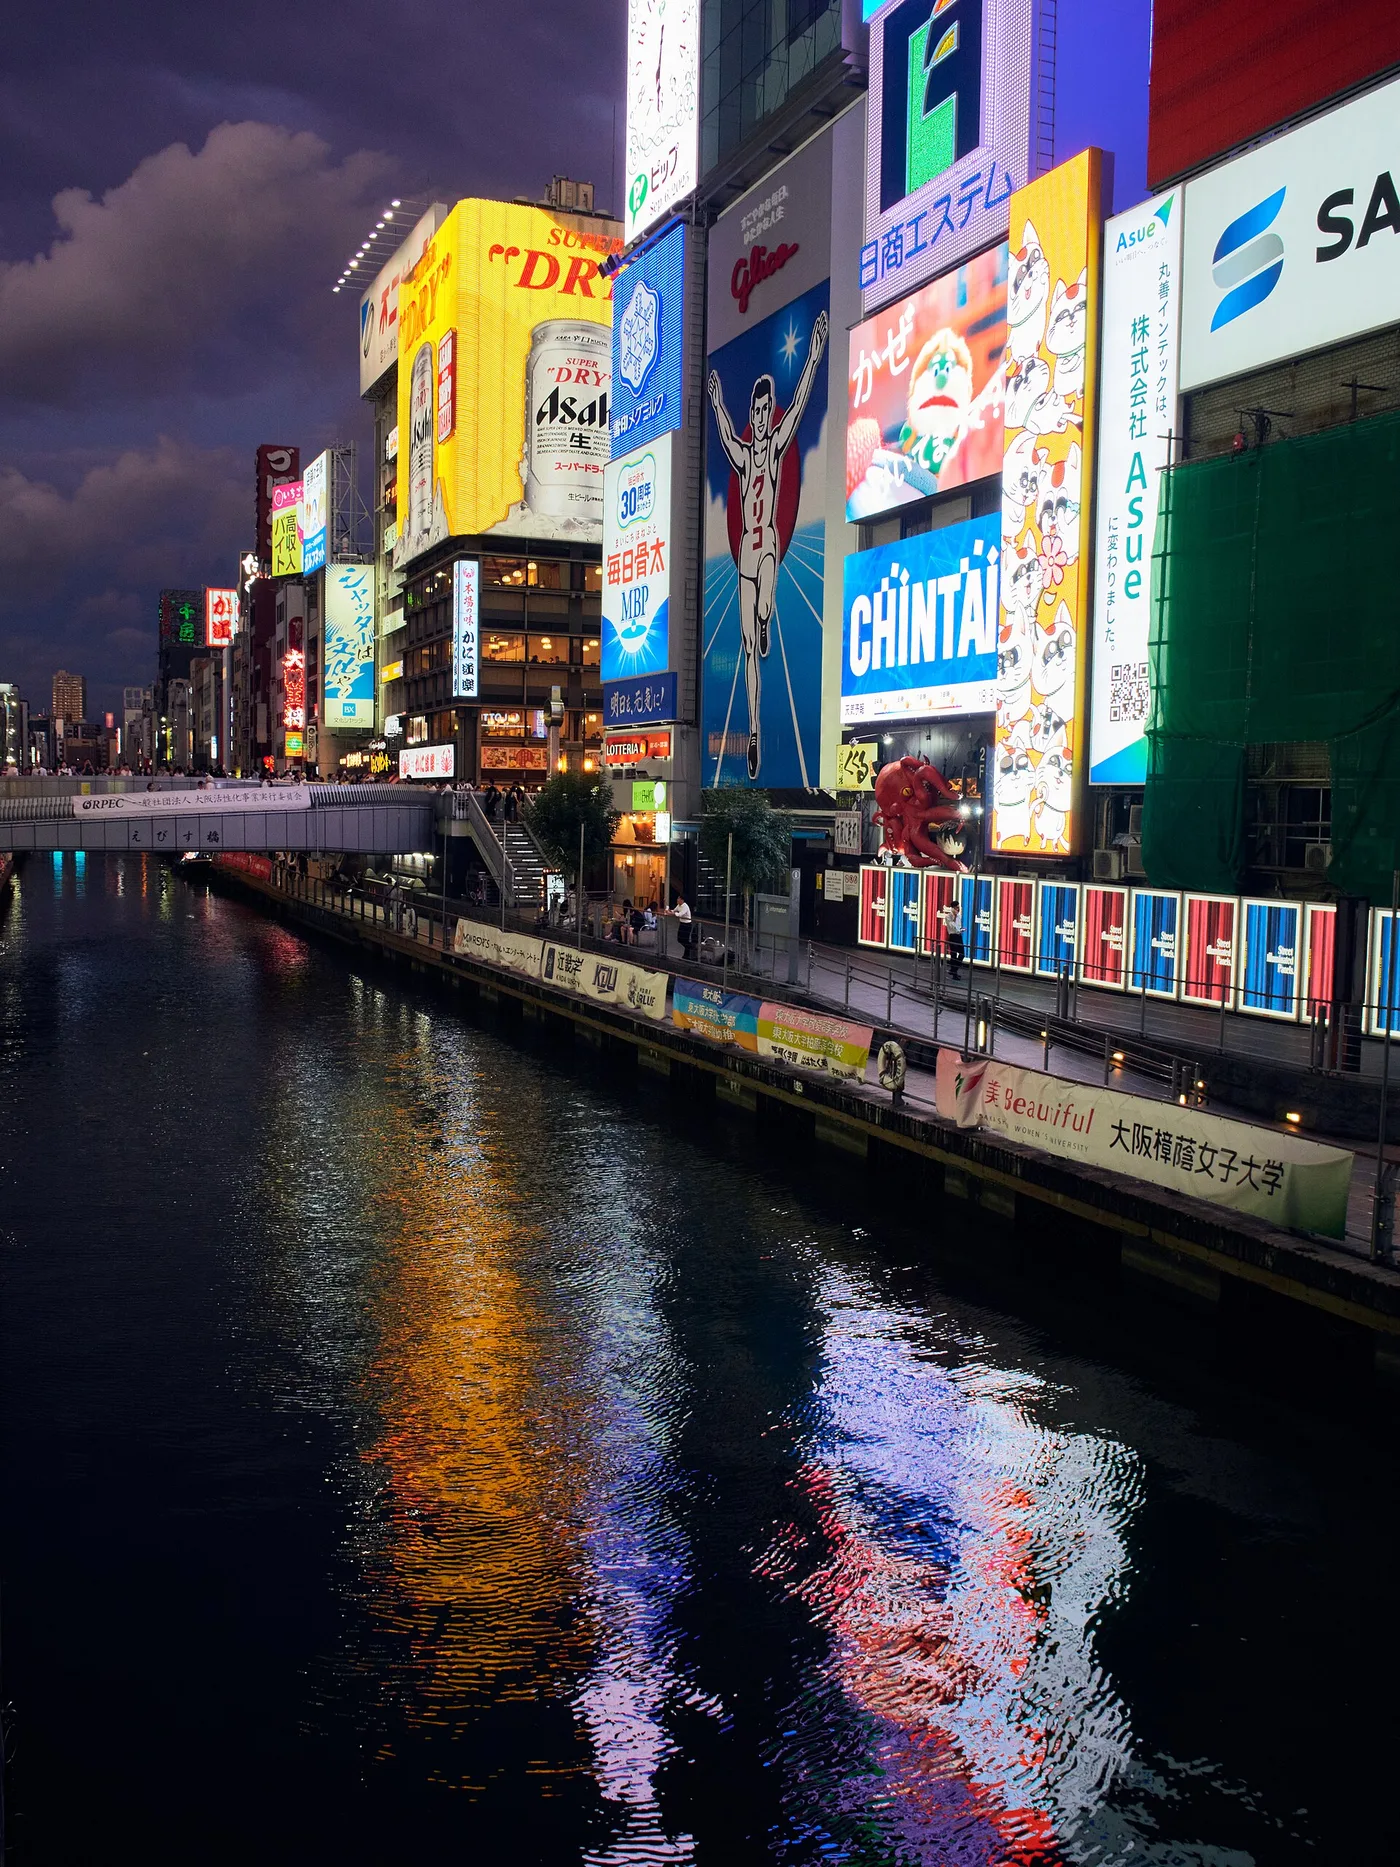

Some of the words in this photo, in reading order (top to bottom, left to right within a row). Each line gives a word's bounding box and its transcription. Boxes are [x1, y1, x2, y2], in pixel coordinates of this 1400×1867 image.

[652, 142, 679, 192] ピップ
[859, 161, 1011, 291] 日商エステム
[1116, 222, 1155, 253] Asue
[731, 243, 799, 314] Glico
[566, 357, 598, 368] SUPER
[852, 302, 915, 409] かぜ
[1155, 261, 1171, 419] 丸善インテックは、
[1128, 314, 1150, 441] 株式会社
[536, 386, 611, 430] Asah
[613, 394, 664, 438] 雪印メグミルク
[554, 461, 605, 474] スーパードラ
[569, 432, 592, 449] 生
[752, 468, 765, 551] グリコ
[1124, 451, 1149, 600] Asue
[274, 516, 285, 573] バイト
[285, 514, 297, 572] 高収入
[607, 537, 665, 585] 毎日骨太
[463, 581, 474, 626] 本場の味
[621, 585, 649, 622] MBP
[1104, 516, 1119, 652] に変わりました。
[462, 631, 475, 691] かに道楽
[606, 743, 639, 756] LOTTERIA
[985, 1080, 1001, 1107] 美
[1004, 1088, 1094, 1134] Beauiful
[1109, 1119, 1284, 1196] 大阪樟蔭女子大学
